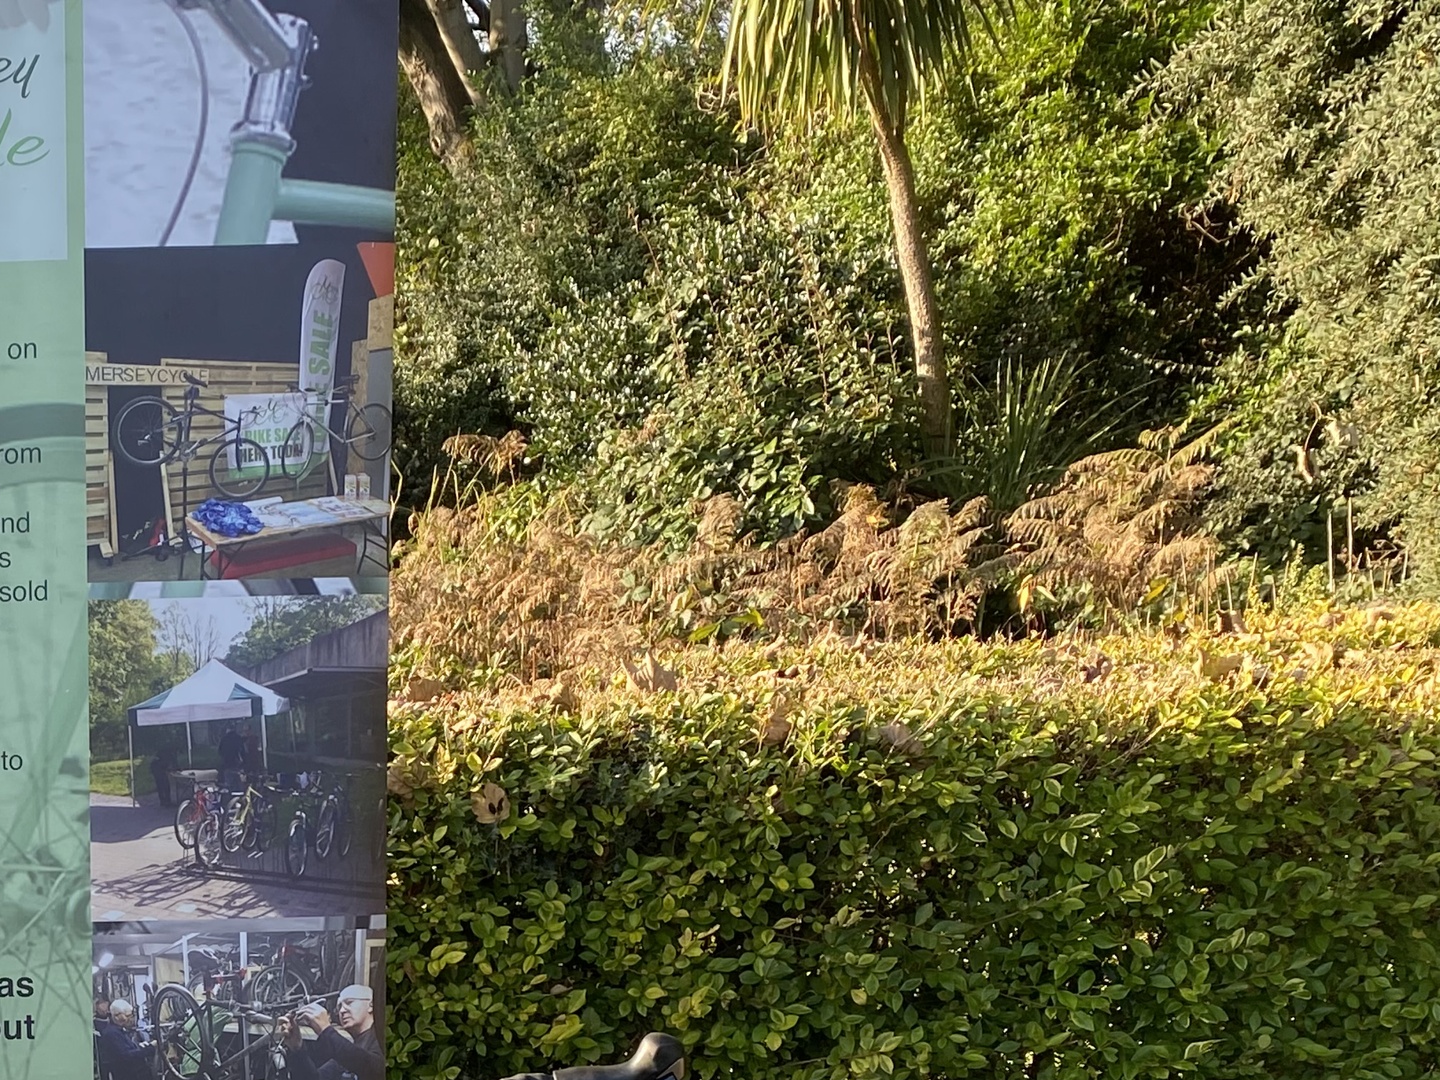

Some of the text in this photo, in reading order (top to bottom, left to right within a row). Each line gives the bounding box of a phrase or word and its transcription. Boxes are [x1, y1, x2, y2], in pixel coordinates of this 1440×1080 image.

[7, 342, 37, 360] on
[309, 310, 333, 375] SALE
[1, 751, 24, 771] to
